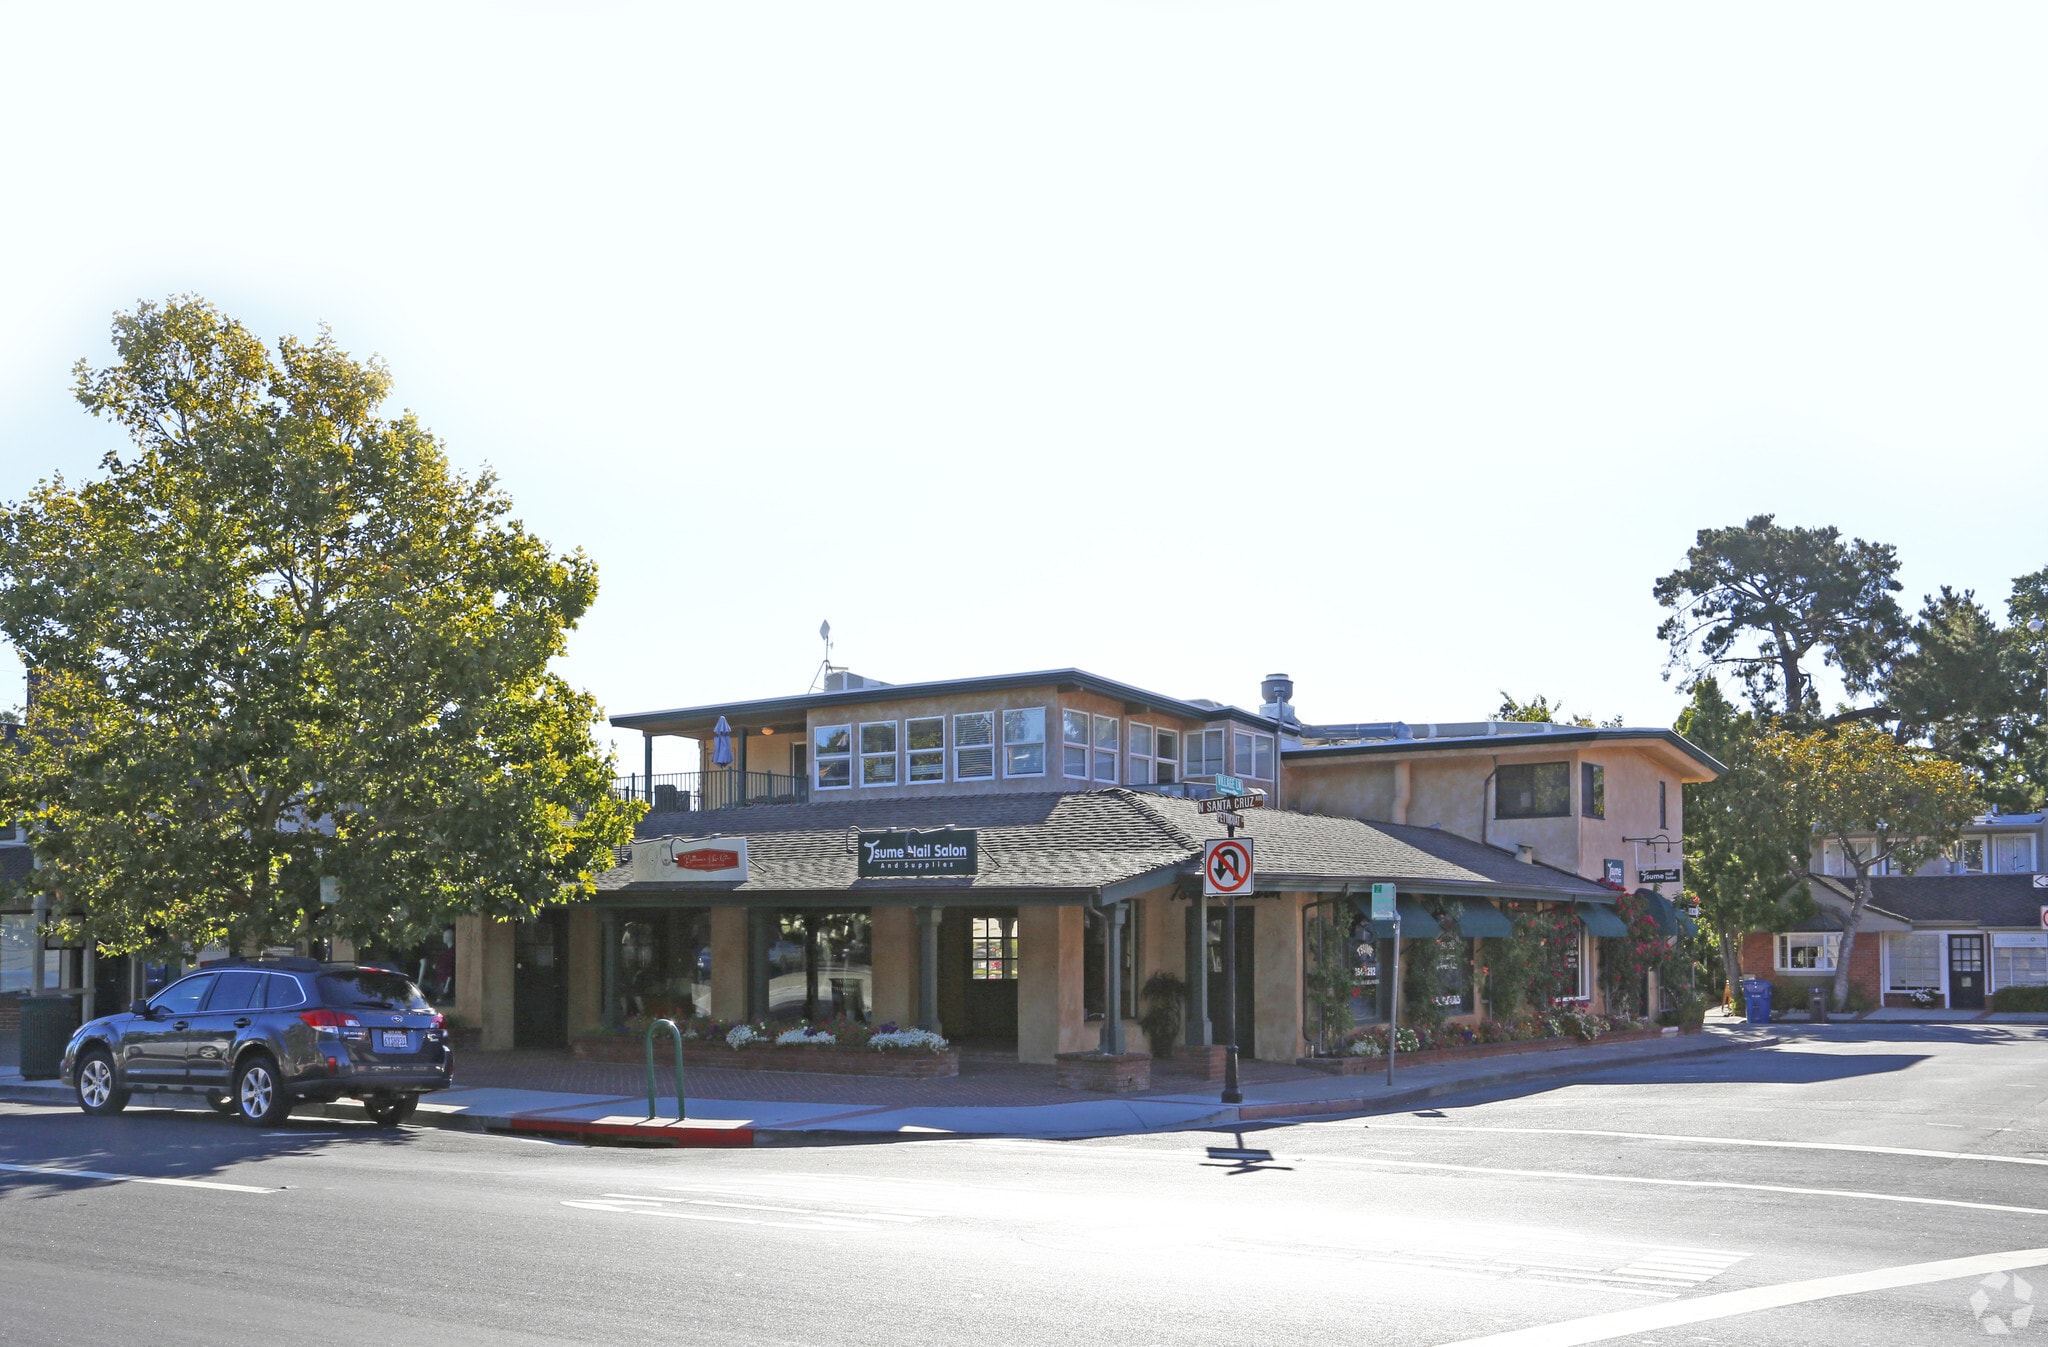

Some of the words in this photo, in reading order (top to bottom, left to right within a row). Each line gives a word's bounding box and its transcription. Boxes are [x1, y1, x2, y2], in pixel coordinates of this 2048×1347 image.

[1218, 774, 1235, 789] VILLAGE
[1198, 802, 1204, 813] N
[1206, 800, 1231, 812] SANTA
[1234, 796, 1254, 808] CRUZ
[864, 840, 905, 864] Tsume
[934, 843, 967, 857] Salon
[904, 861, 954, 869] Supplies
